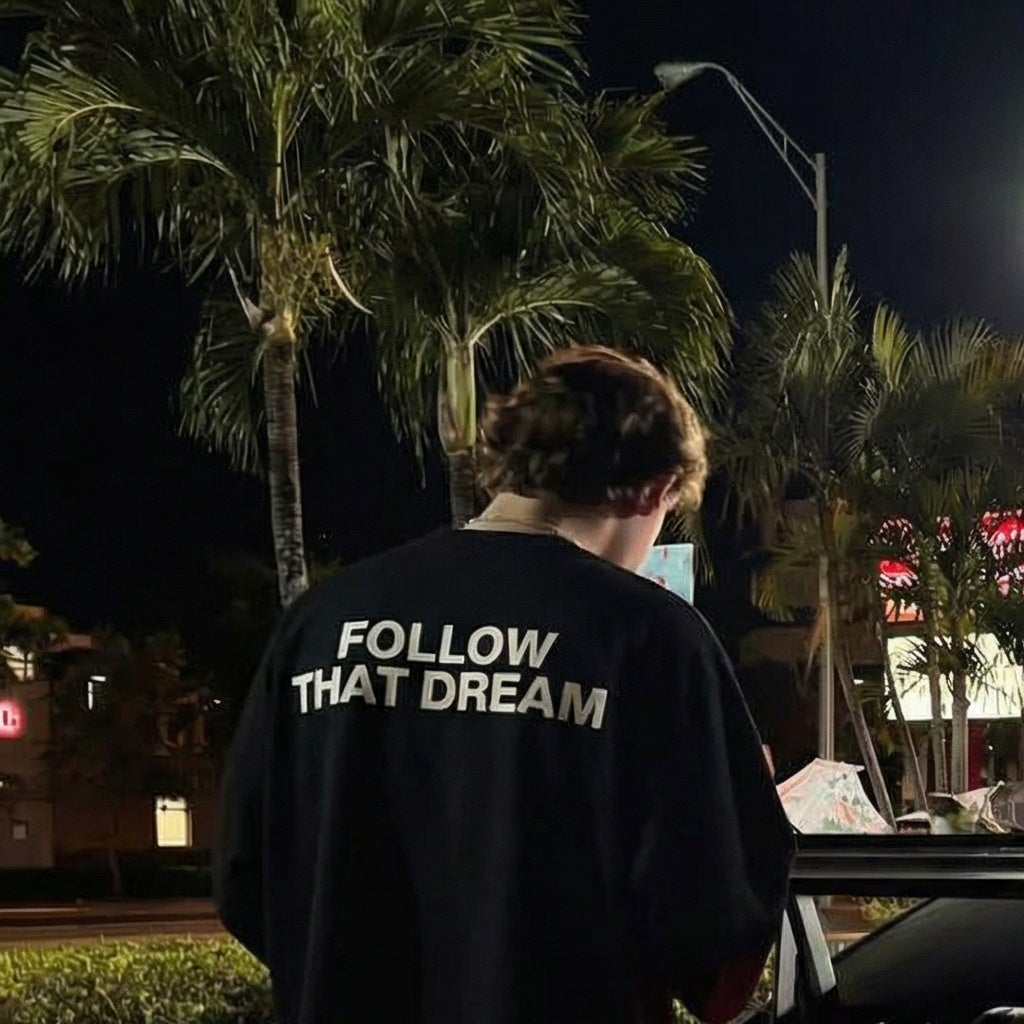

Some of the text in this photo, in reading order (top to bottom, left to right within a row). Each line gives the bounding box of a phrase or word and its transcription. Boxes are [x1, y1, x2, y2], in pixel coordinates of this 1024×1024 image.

[337, 620, 560, 668] FOLLOW
[291, 664, 608, 730] THAT DREAM
